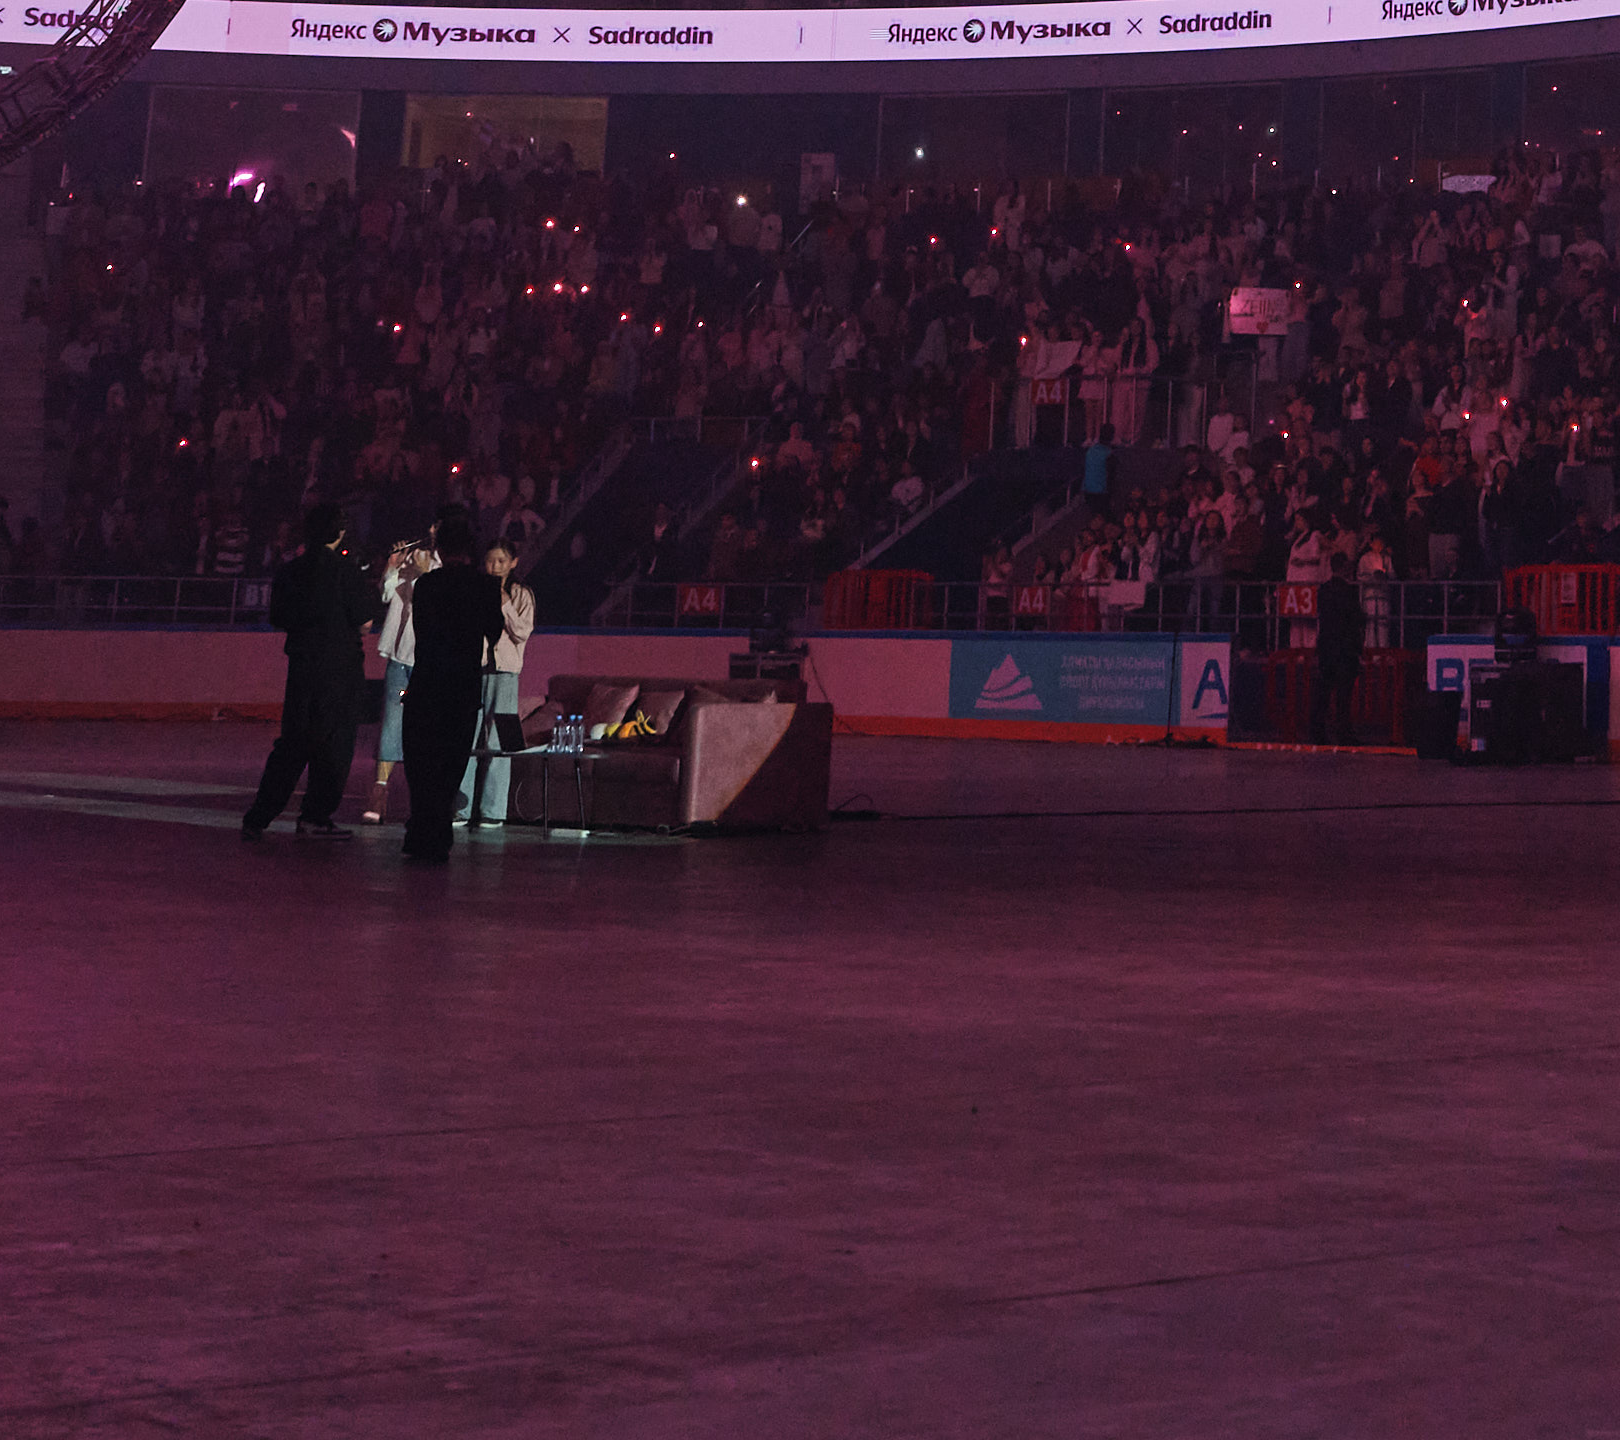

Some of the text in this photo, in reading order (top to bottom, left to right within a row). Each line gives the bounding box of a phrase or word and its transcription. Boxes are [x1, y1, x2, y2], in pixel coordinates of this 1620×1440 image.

[1382, 0, 1443, 21] Яндекс
[291, 19, 367, 41] Яндекс
[403, 22, 535, 46] Музыка
[589, 26, 713, 44] Sadraddin
[888, 24, 957, 44] Яндекс
[991, 21, 1110, 44] Музыка
[1160, 11, 1271, 34] Sadraddin
[1033, 381, 1064, 403] A4
[682, 585, 720, 612] A4
[1018, 586, 1046, 612] A4
[1284, 588, 1315, 614] A3
